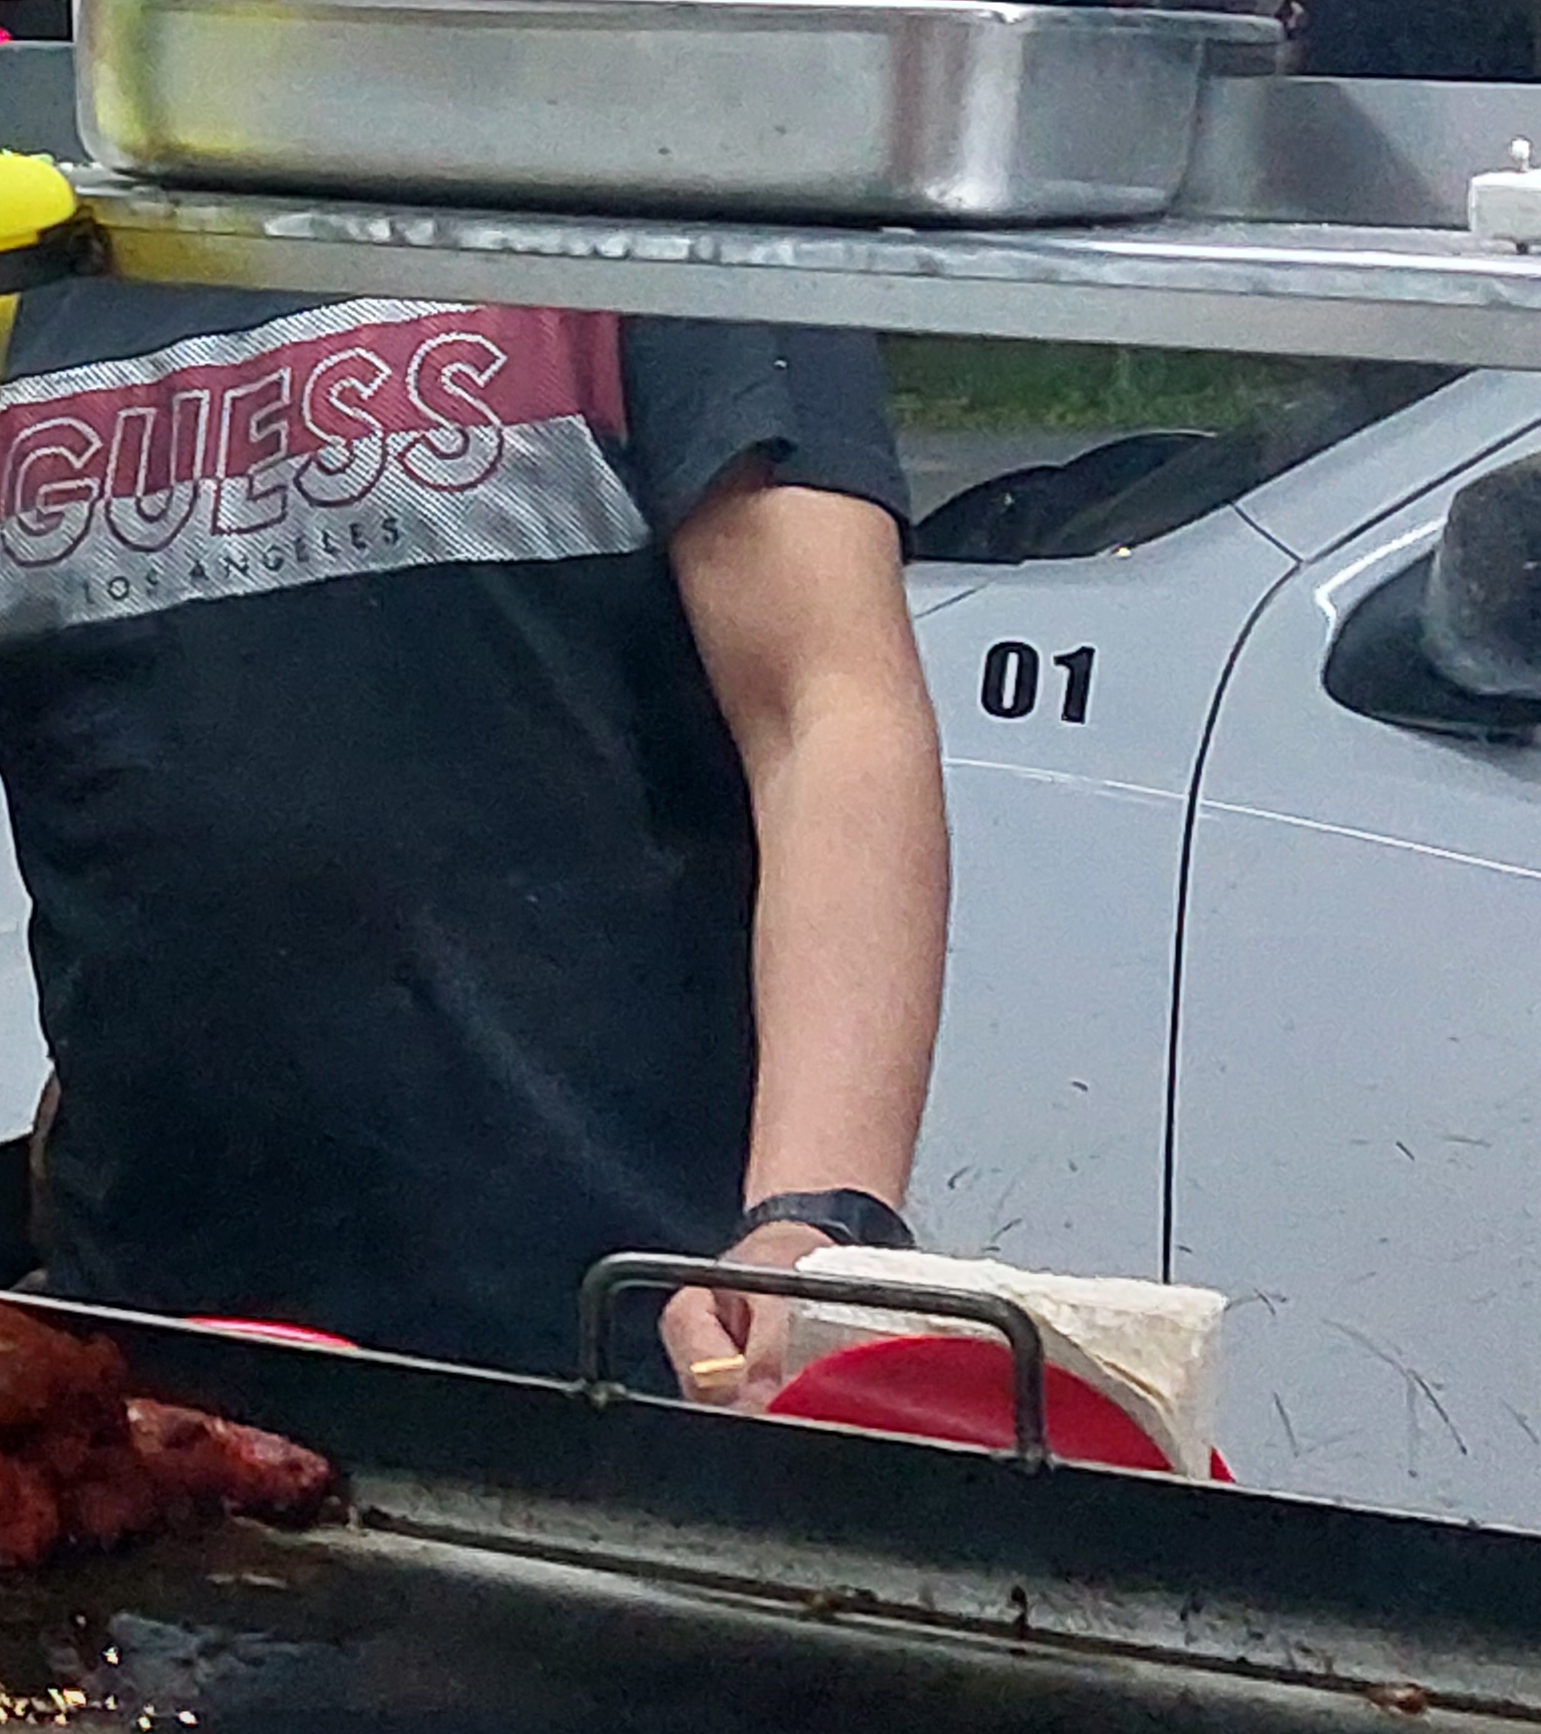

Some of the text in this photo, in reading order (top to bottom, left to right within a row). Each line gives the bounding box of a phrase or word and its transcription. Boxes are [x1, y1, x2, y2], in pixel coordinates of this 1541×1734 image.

[0, 331, 509, 569] GUESS
[80, 517, 401, 605] LOS ANGELES
[980, 641, 1096, 726] 01
